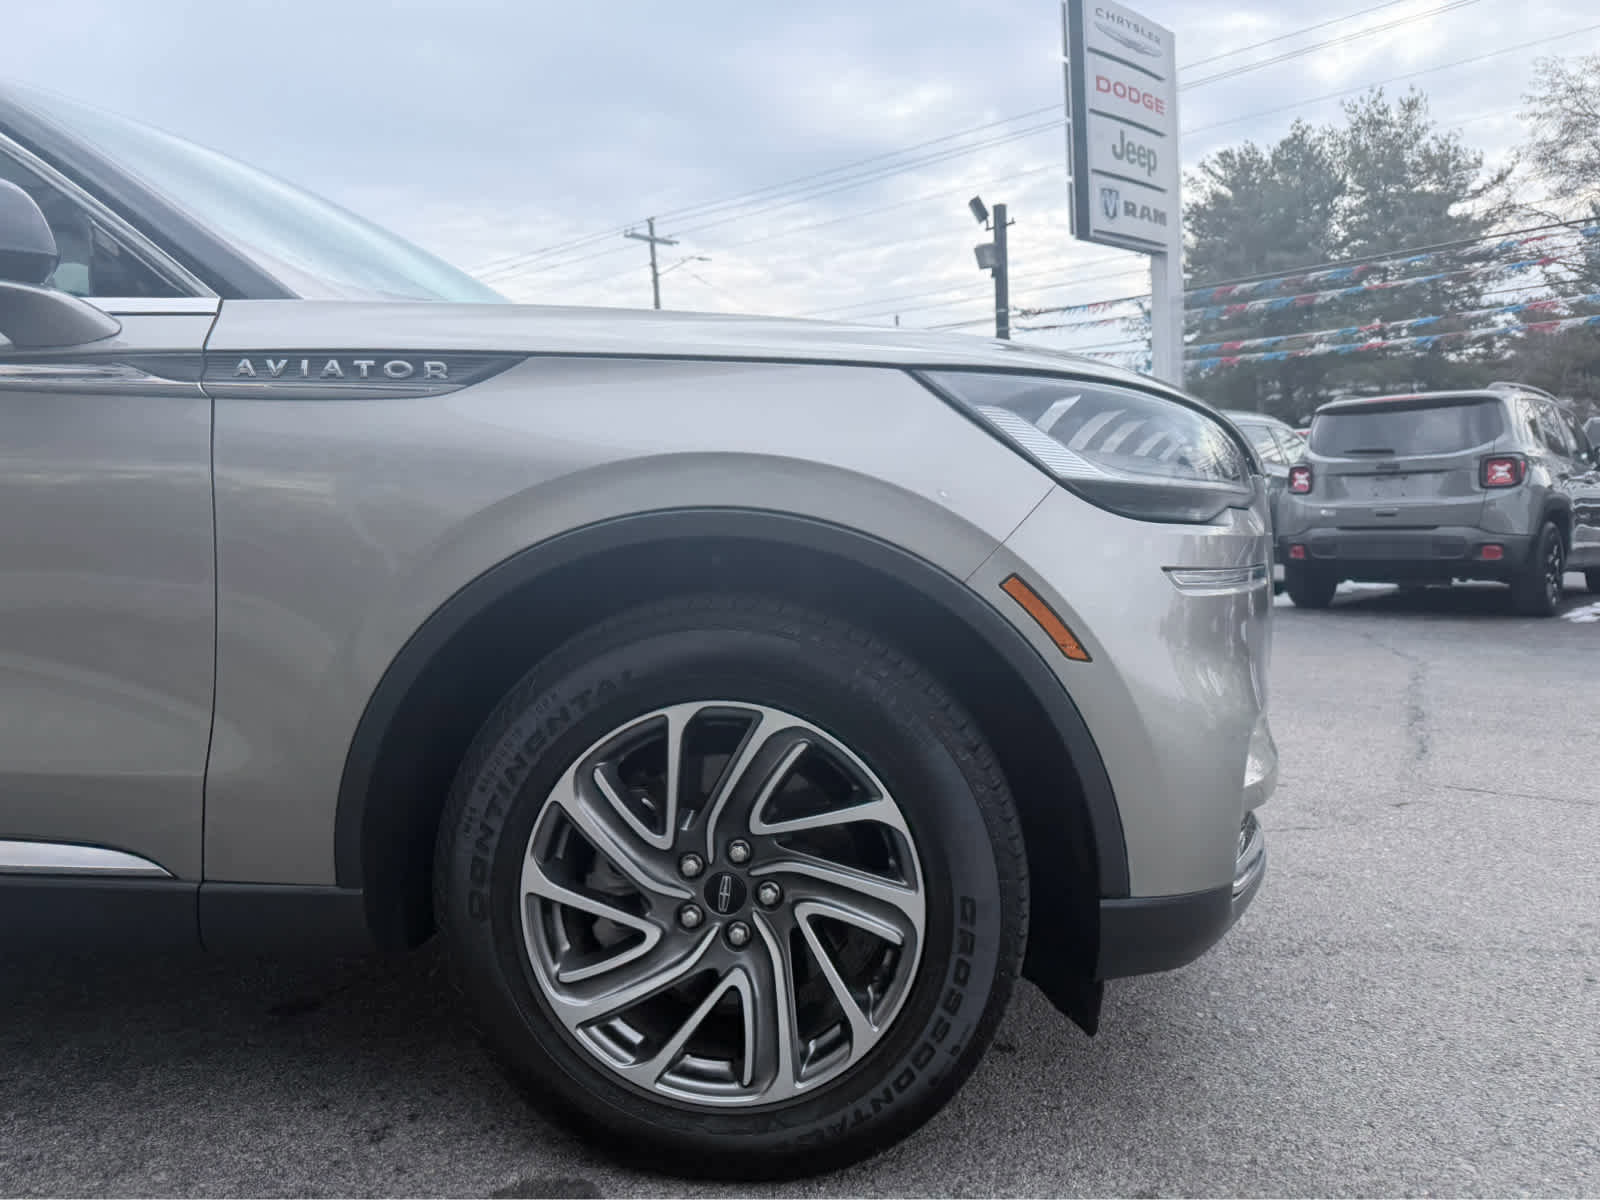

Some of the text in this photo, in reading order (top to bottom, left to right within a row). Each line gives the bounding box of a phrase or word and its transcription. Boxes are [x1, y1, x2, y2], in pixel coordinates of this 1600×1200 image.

[1095, 7, 1161, 46] CHRYSLER
[1095, 74, 1165, 116] DODGE
[1112, 129, 1157, 176] Jeep
[1123, 200, 1168, 227] RAM
[232, 358, 449, 380] AVIATOR
